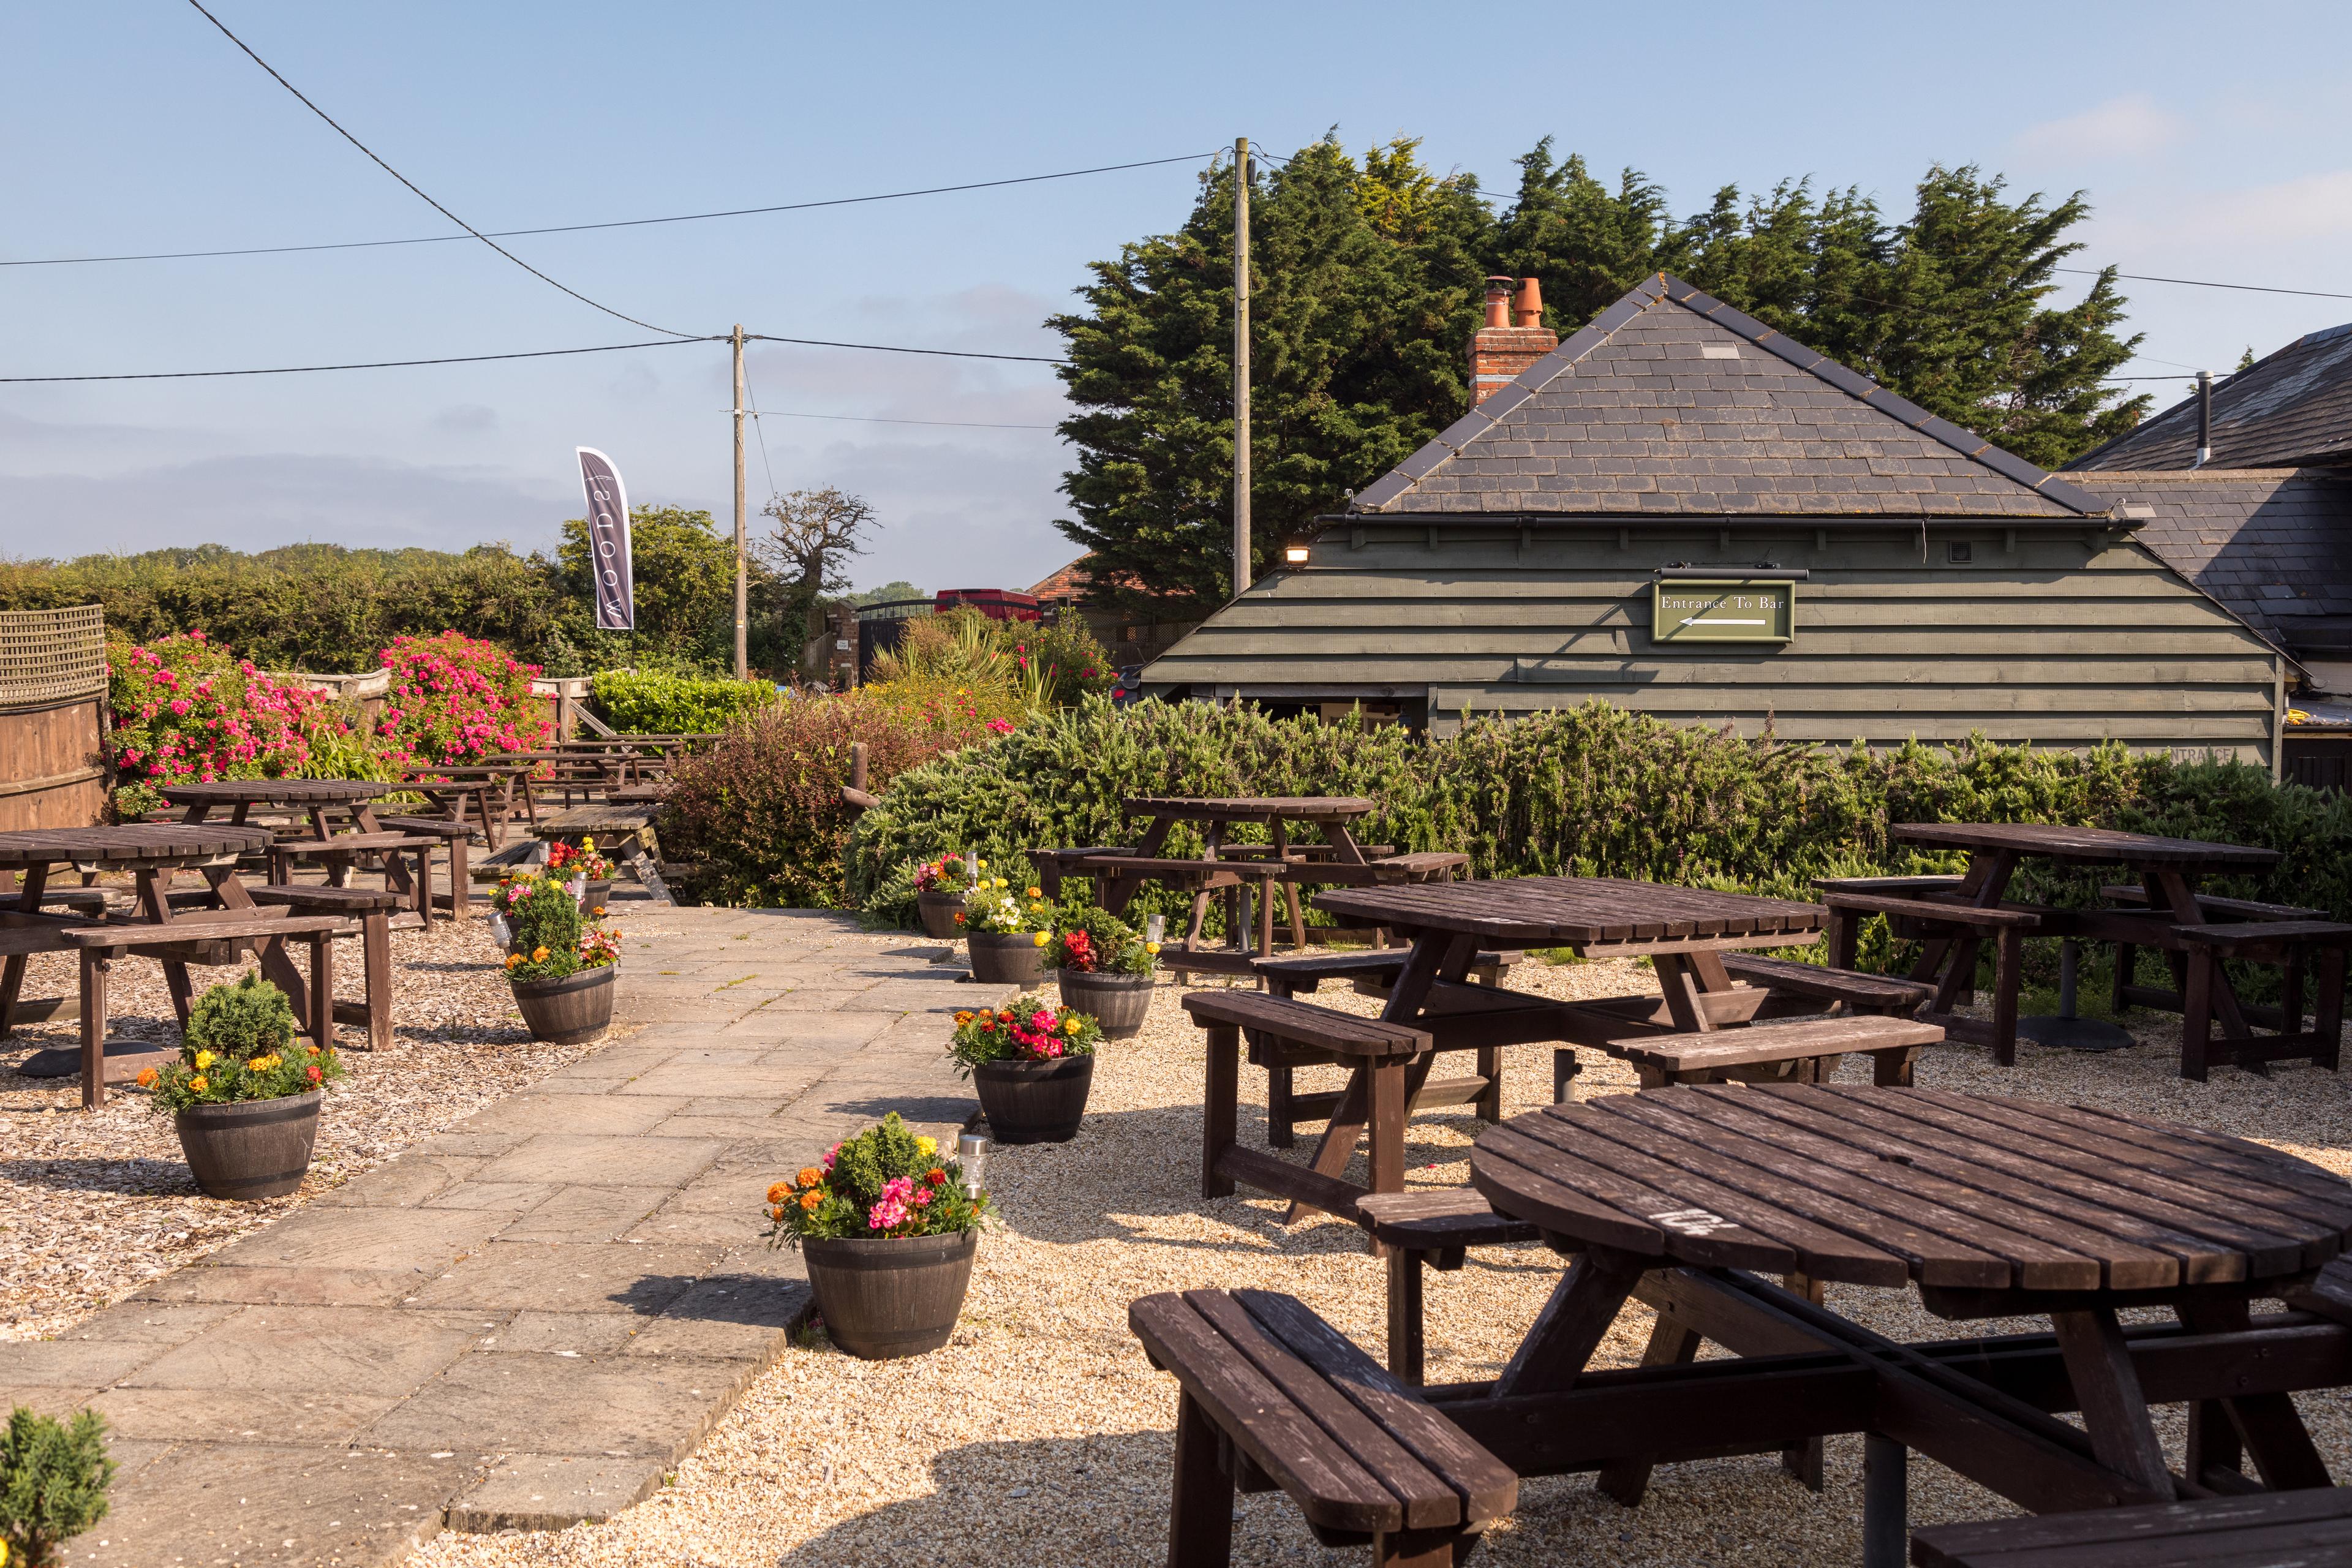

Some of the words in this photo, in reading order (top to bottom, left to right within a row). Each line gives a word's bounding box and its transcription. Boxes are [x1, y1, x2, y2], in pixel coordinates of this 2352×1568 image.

[1661, 596, 1727, 609] Entrance
[1733, 596, 1752, 609] To
[1759, 596, 1784, 609] Bar
